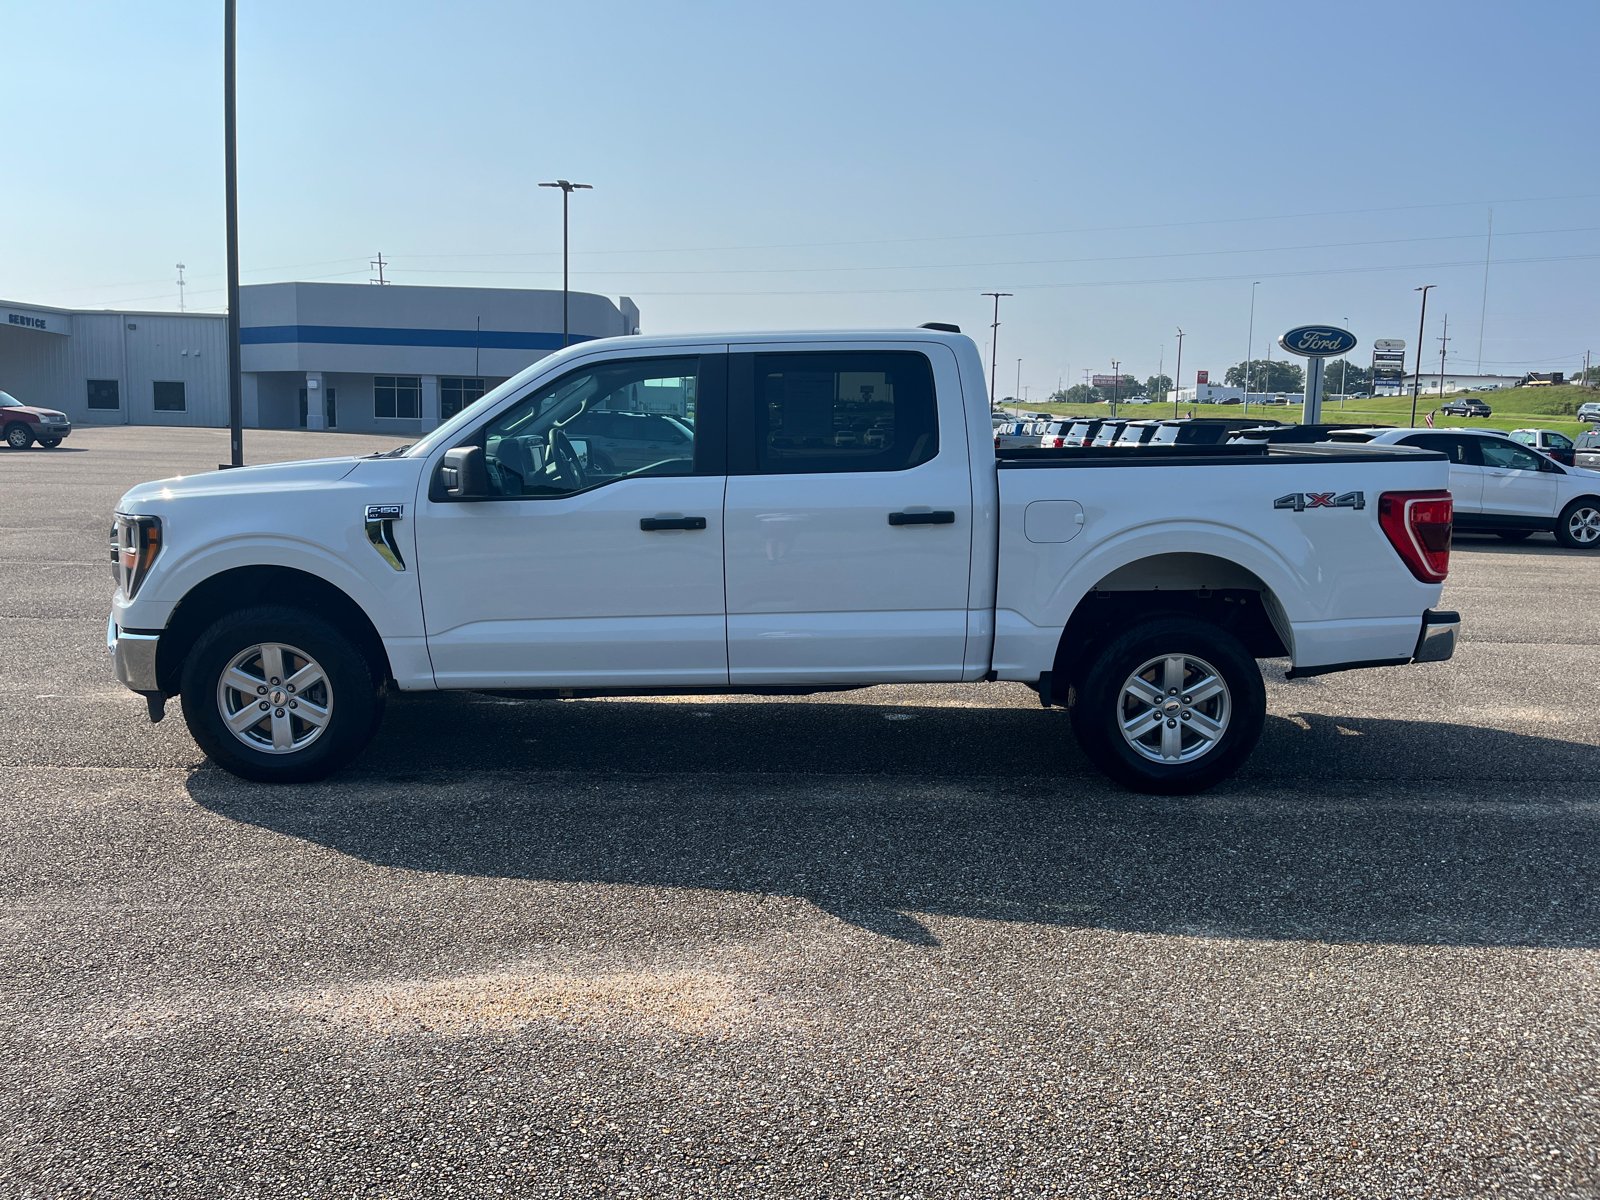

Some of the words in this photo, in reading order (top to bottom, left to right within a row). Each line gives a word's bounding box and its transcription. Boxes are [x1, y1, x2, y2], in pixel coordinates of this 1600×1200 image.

[9, 314, 46, 329] SERVICE
[1298, 331, 1342, 350] Ford
[1274, 491, 1366, 512] 4X4
